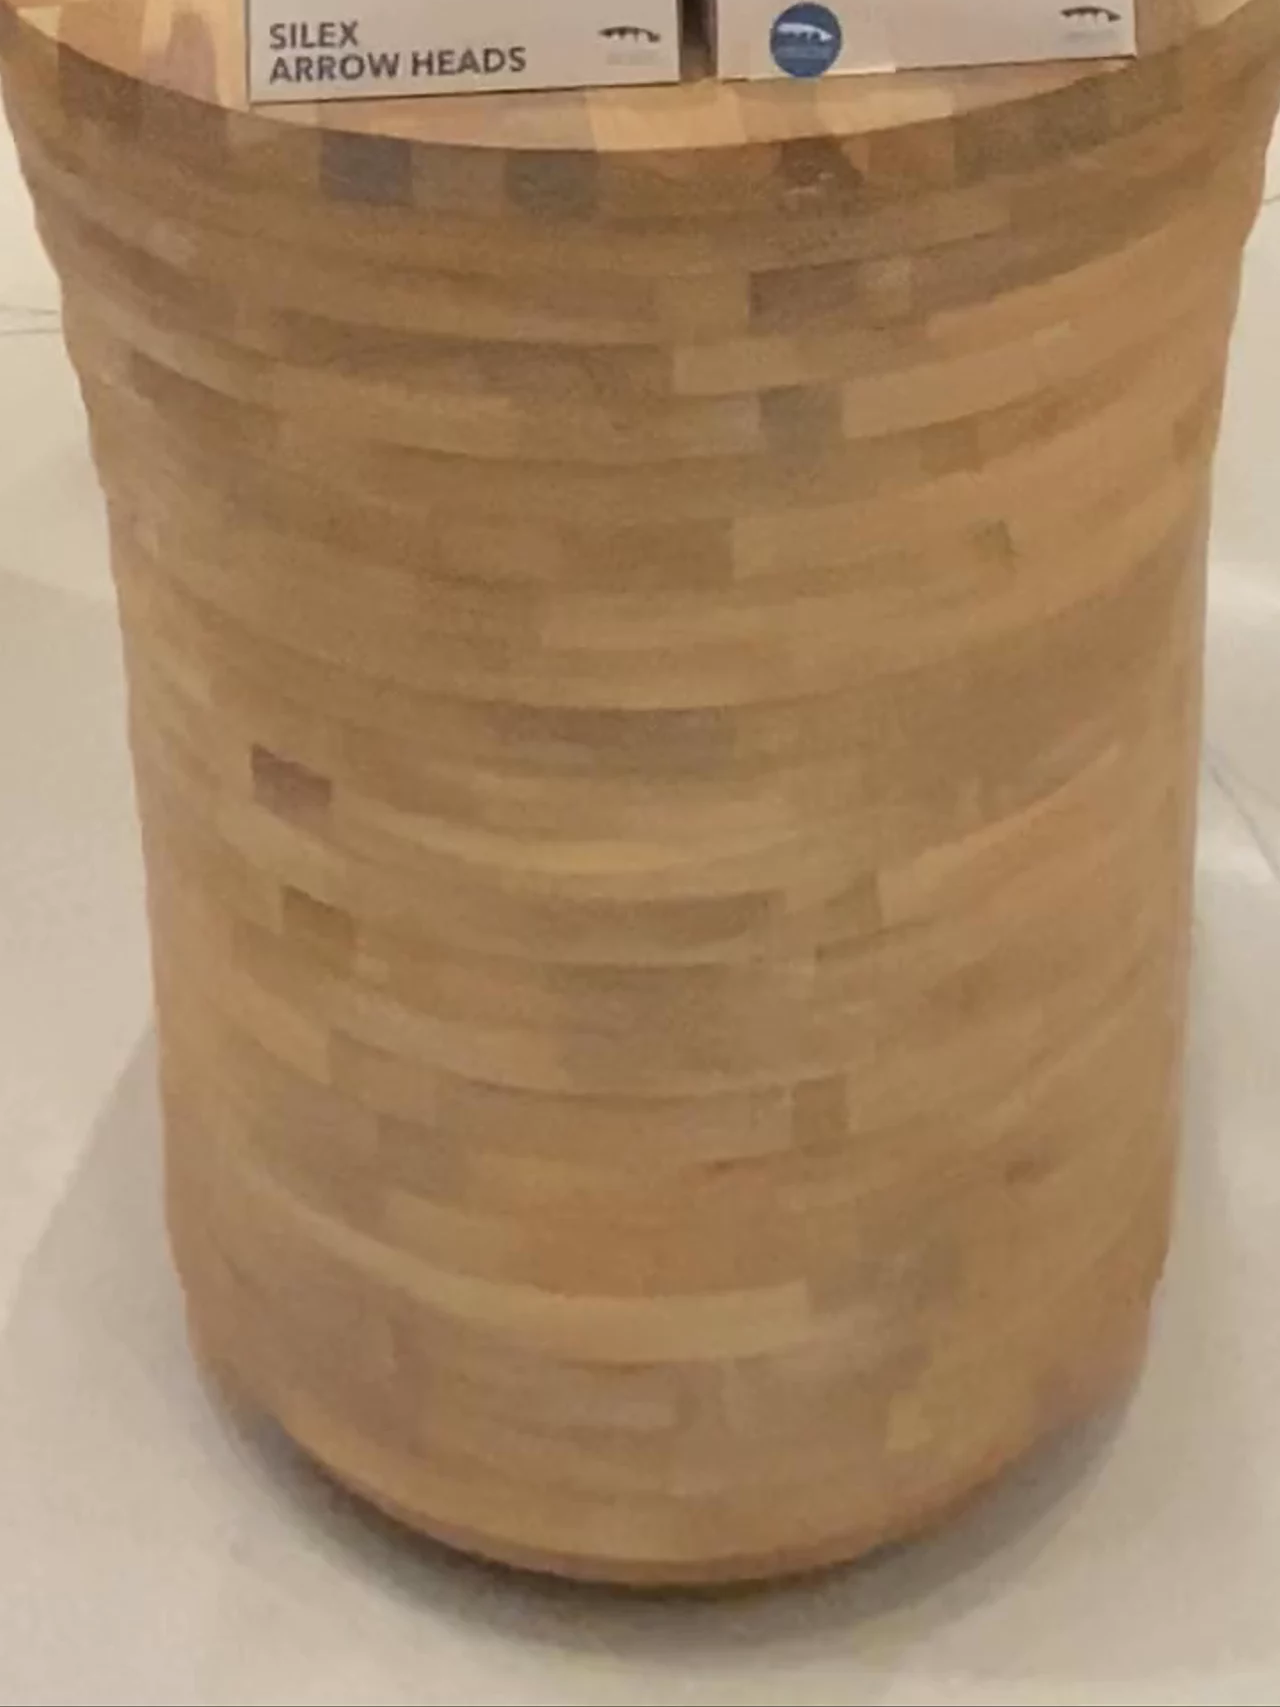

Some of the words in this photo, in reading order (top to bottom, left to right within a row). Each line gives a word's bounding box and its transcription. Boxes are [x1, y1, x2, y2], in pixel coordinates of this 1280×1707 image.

[269, 20, 359, 50] SILEX
[269, 51, 400, 84] ARROW
[411, 46, 527, 77] HEADS
